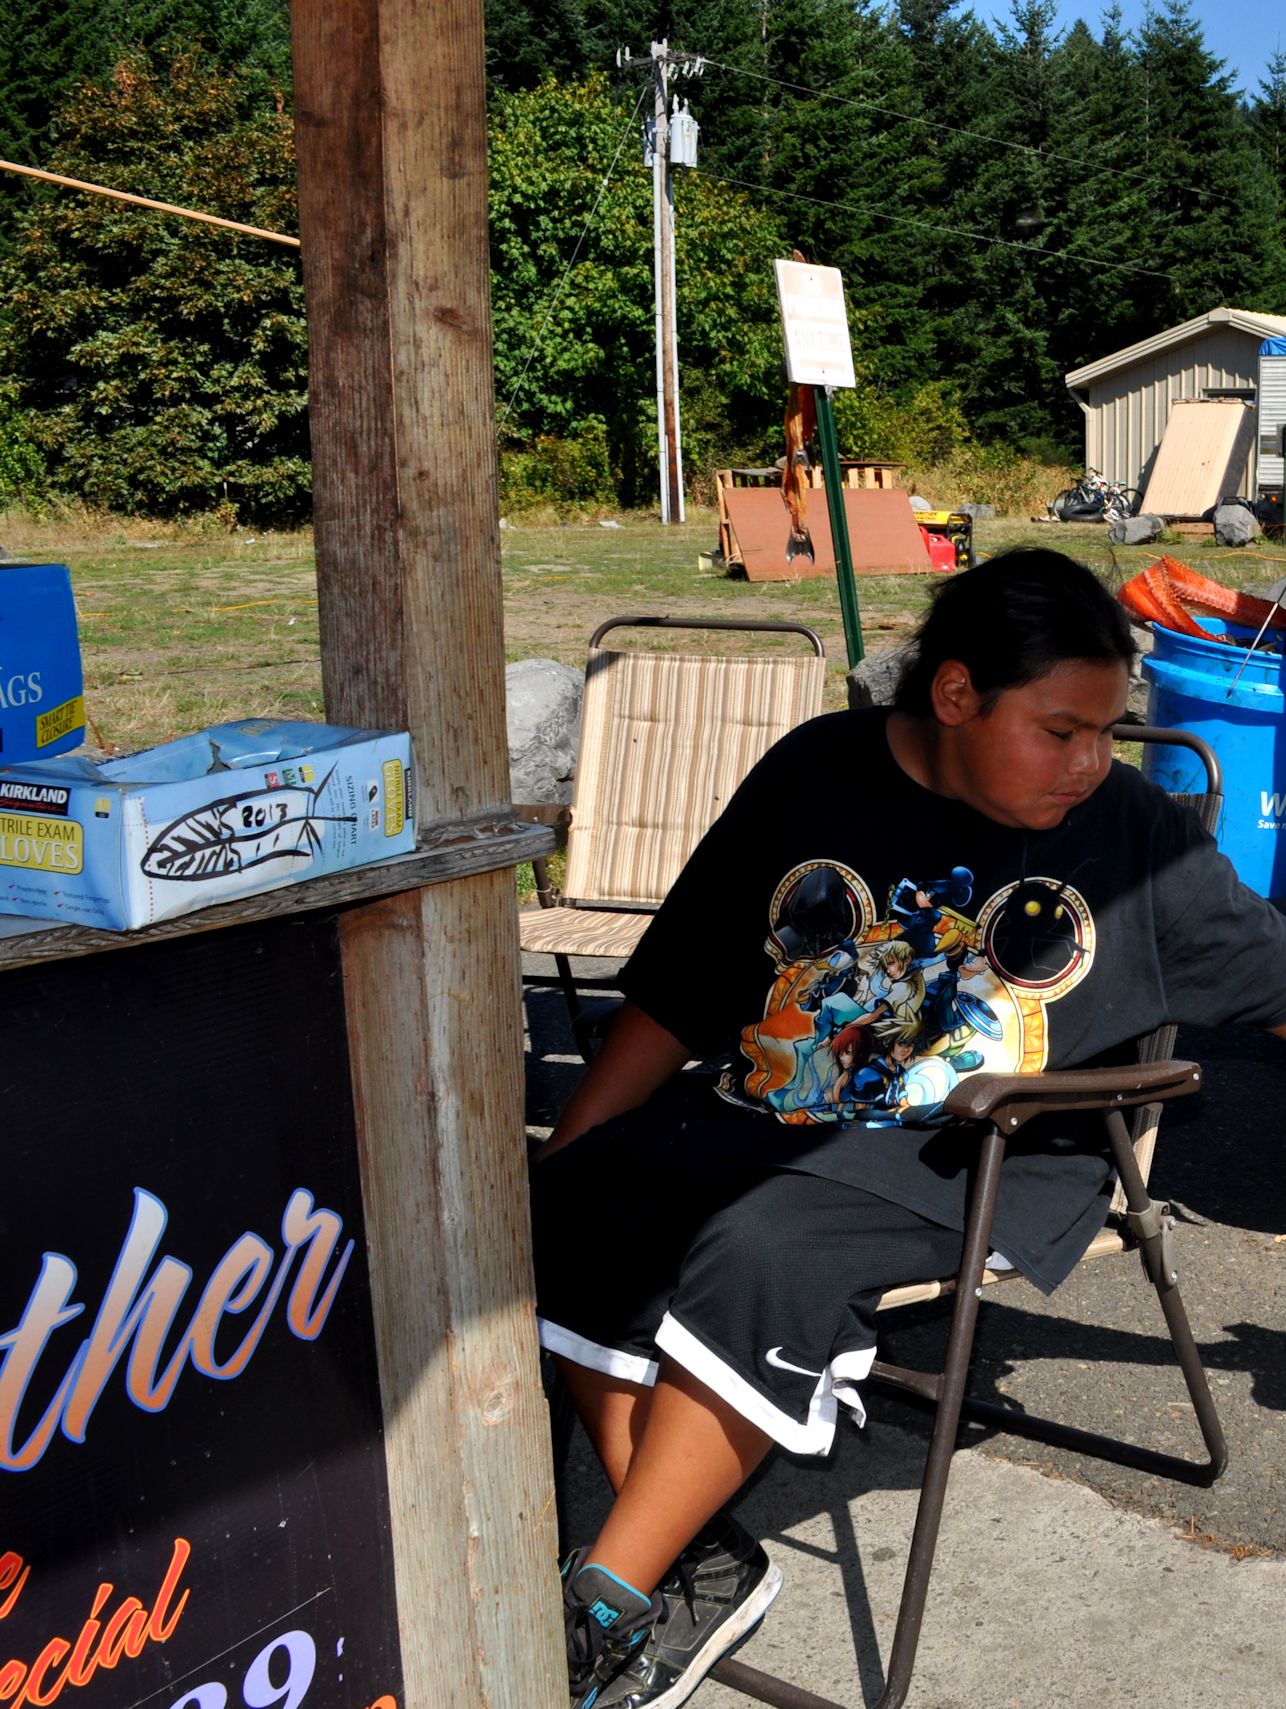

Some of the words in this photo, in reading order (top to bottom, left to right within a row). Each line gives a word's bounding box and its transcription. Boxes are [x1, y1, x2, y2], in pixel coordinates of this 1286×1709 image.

[39, 704, 65, 731] SMART
[65, 701, 77, 719] TIE
[41, 715, 74, 744] CLOSURE
[0, 783, 68, 804] KIRKLAND
[346, 775, 357, 810] SIZING
[242, 803, 288, 828] 2013
[1257, 819, 1280, 830] Save
[37, 822, 75, 841] EXAM
[0, 835, 79, 869] LOVES
[0, 1187, 354, 1472] ther
